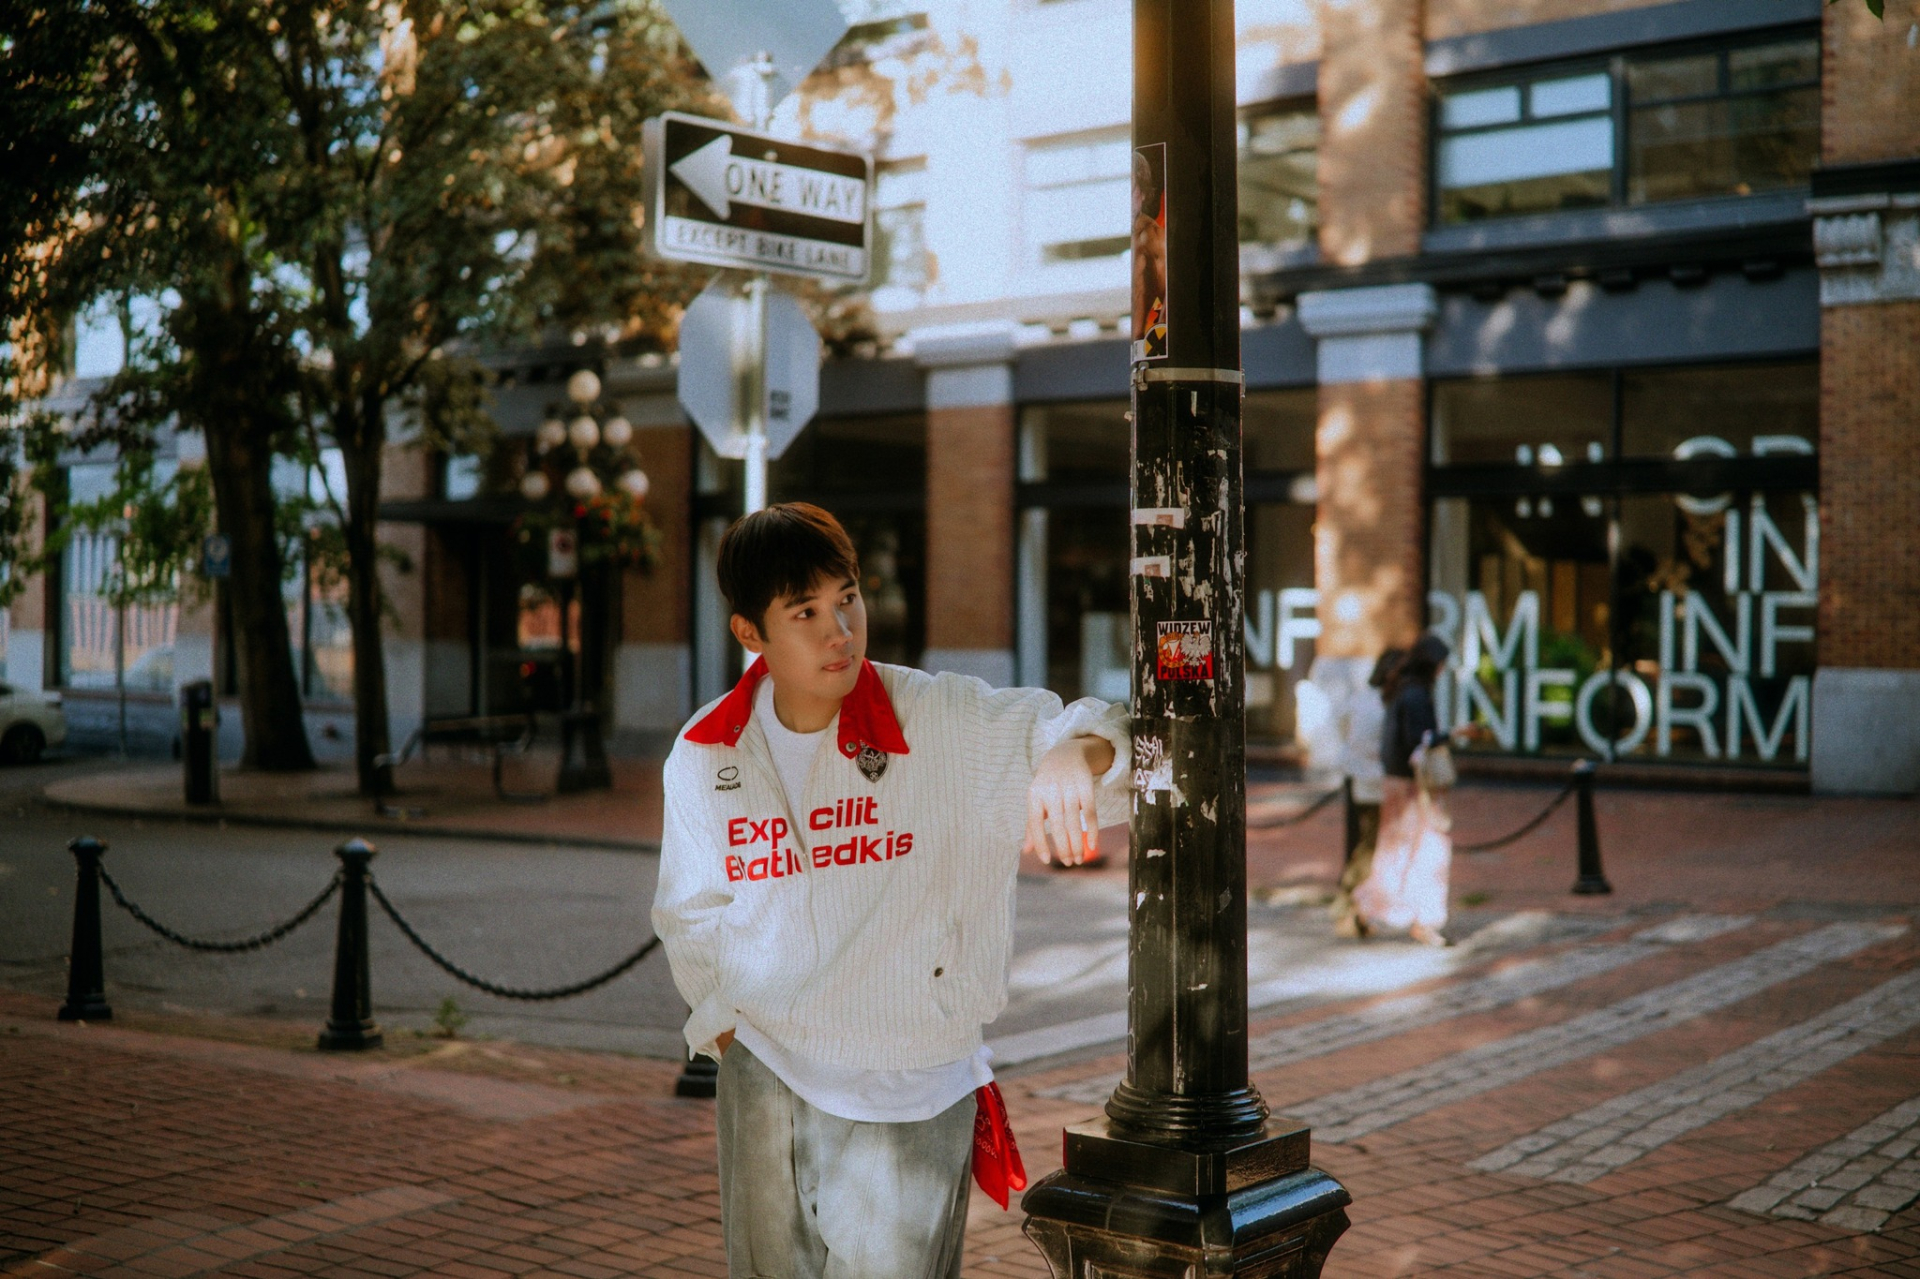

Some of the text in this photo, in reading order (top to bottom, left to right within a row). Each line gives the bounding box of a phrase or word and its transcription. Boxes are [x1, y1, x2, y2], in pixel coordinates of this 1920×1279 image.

[725, 162, 857, 216] ONE WAY
[676, 224, 849, 266] EXCEPT BIKE LANE
[1158, 622, 1211, 635] WIDZEW
[1434, 667, 1810, 761] INFORM
